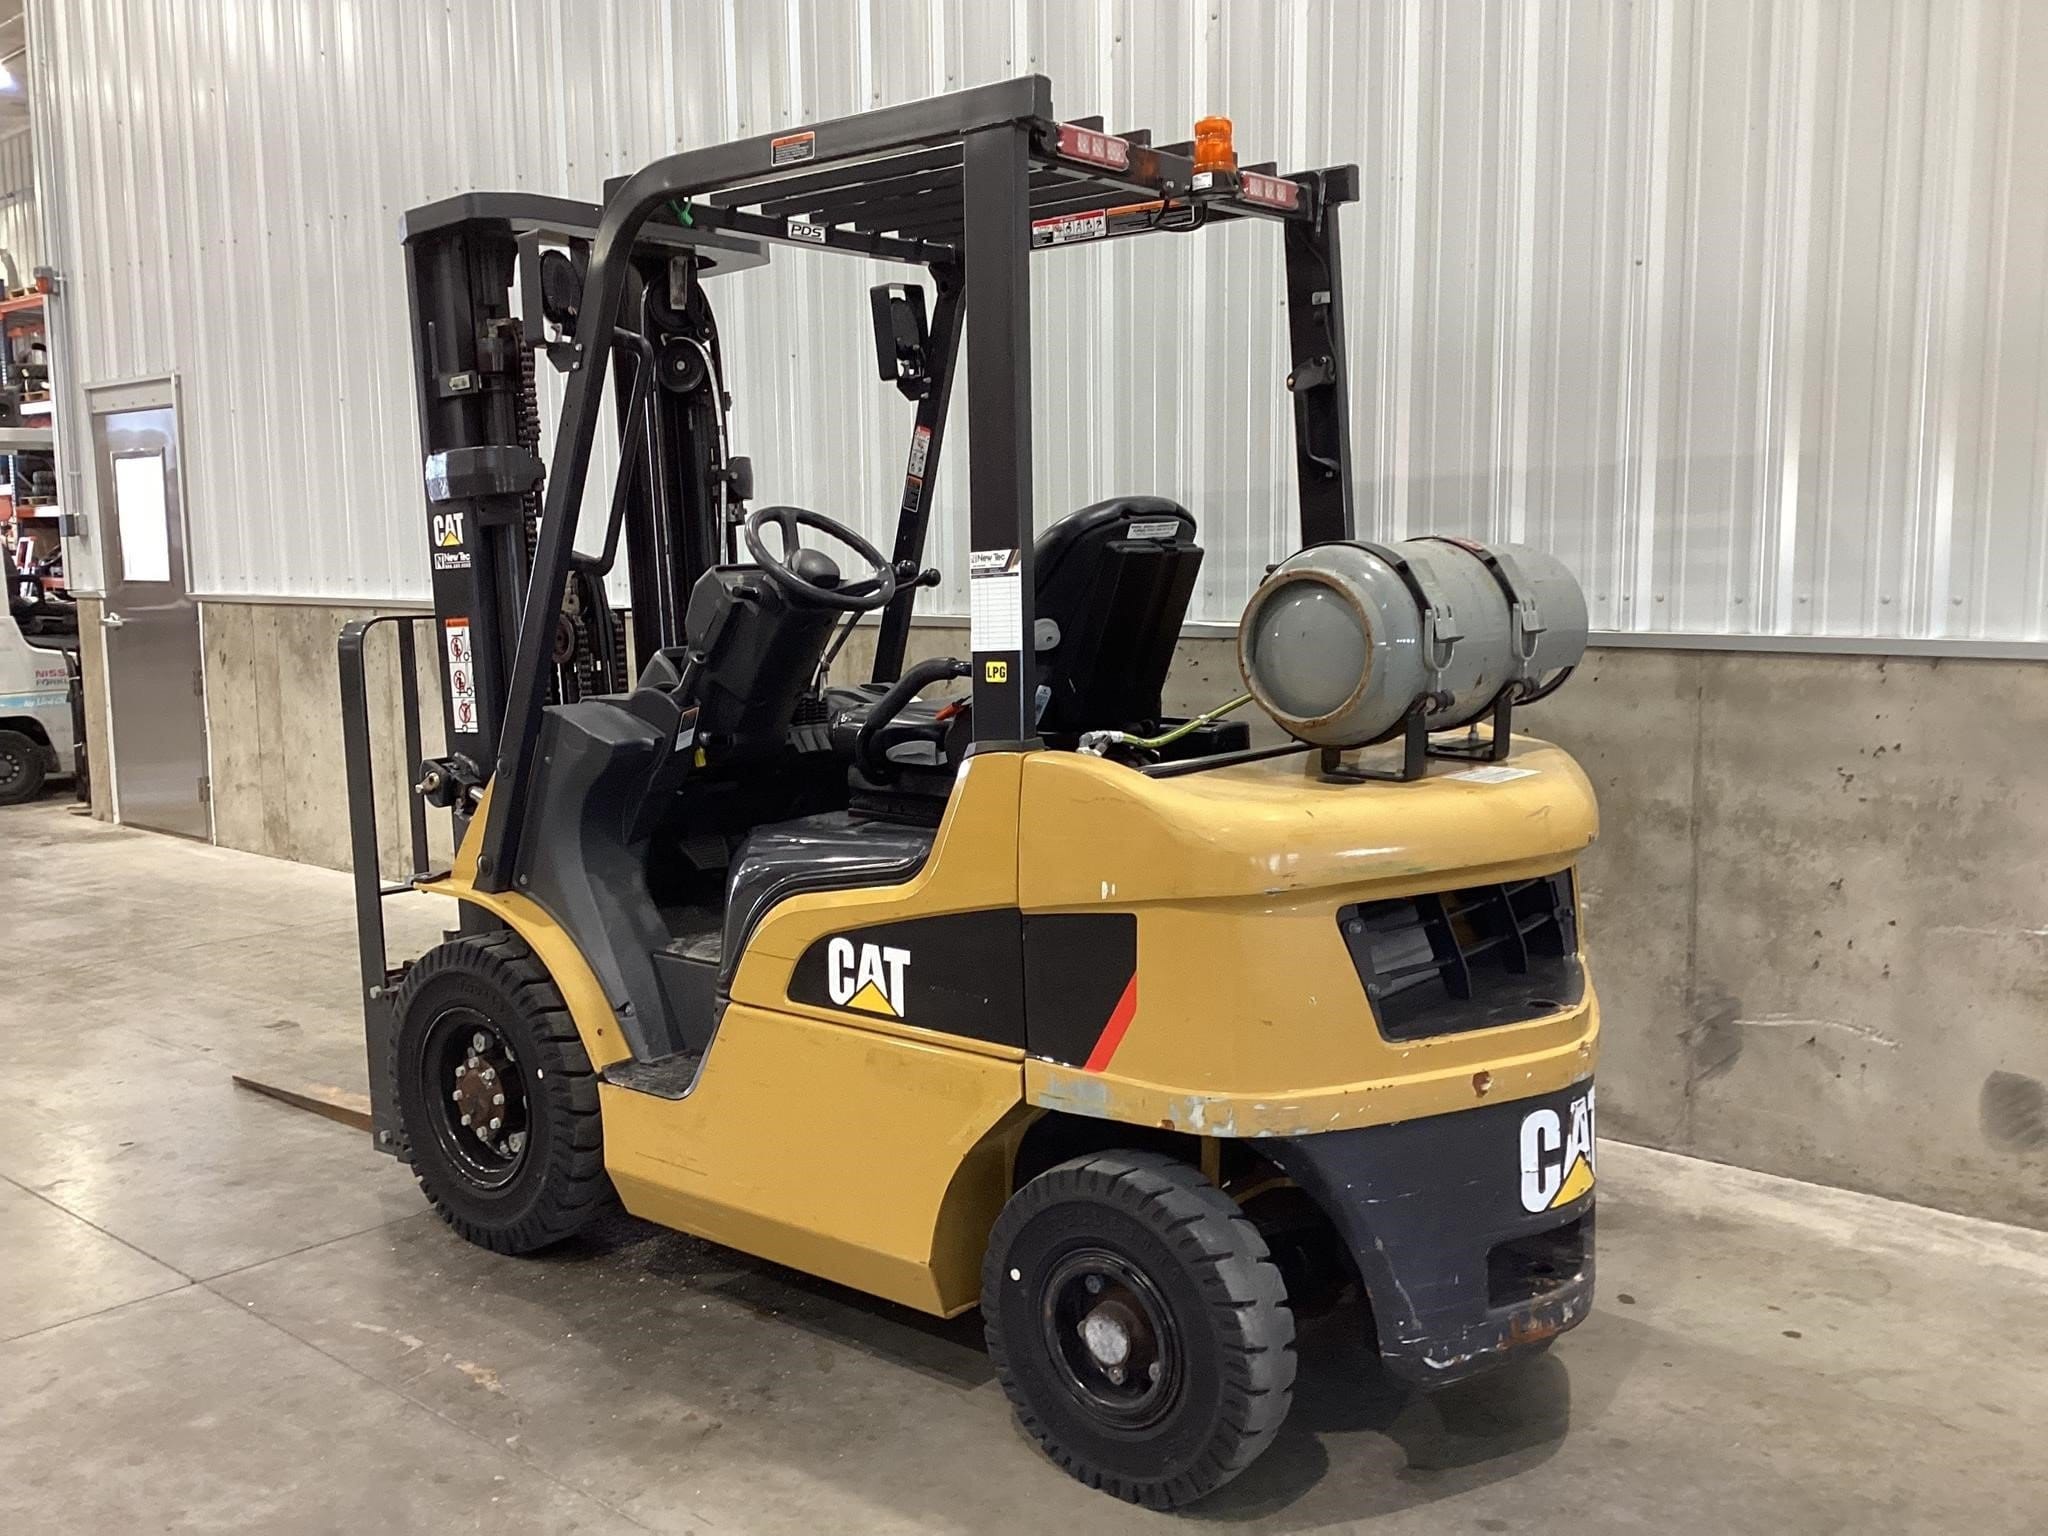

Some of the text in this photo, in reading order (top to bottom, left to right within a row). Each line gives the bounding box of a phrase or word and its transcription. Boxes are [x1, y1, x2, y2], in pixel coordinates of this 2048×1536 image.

[791, 224, 822, 238] PDS
[433, 512, 464, 547] CAT
[977, 554, 992, 563] New
[35, 669, 68, 678] NISS
[987, 665, 1006, 679] LPG
[828, 937, 911, 1018] CAT
